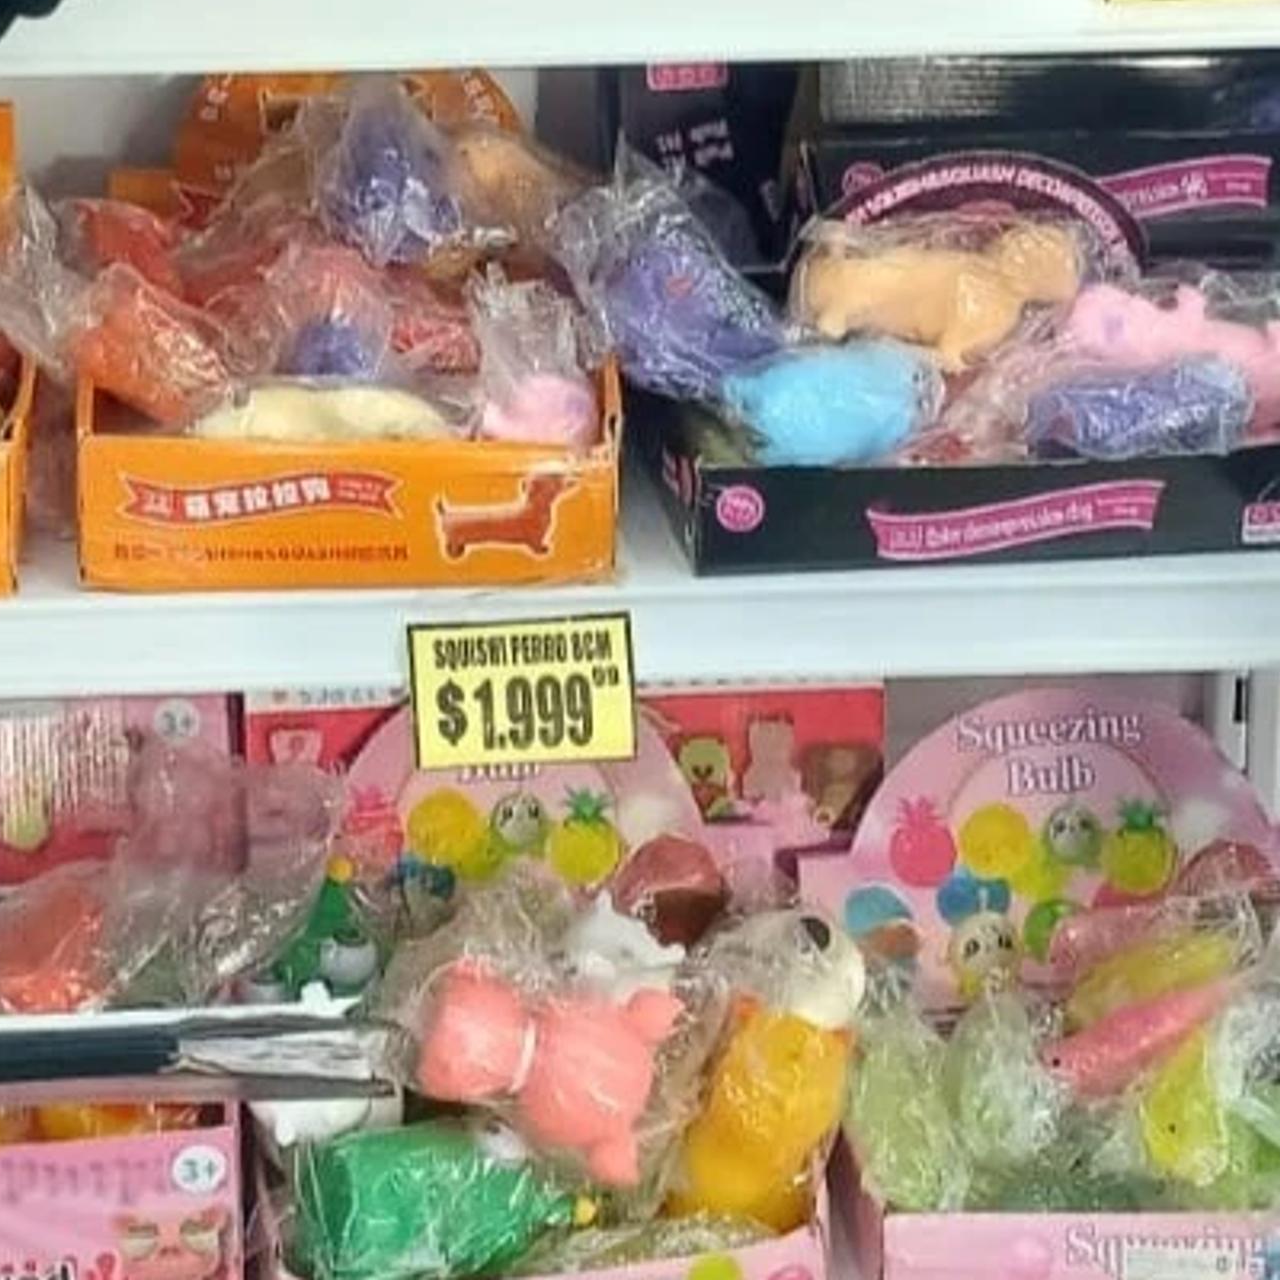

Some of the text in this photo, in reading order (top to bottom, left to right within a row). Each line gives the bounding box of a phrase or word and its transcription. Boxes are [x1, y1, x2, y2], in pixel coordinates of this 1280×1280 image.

[510, 631, 568, 666] PERRO
[954, 708, 1143, 754] Squeezing
[1006, 754, 1096, 797] Bulb
